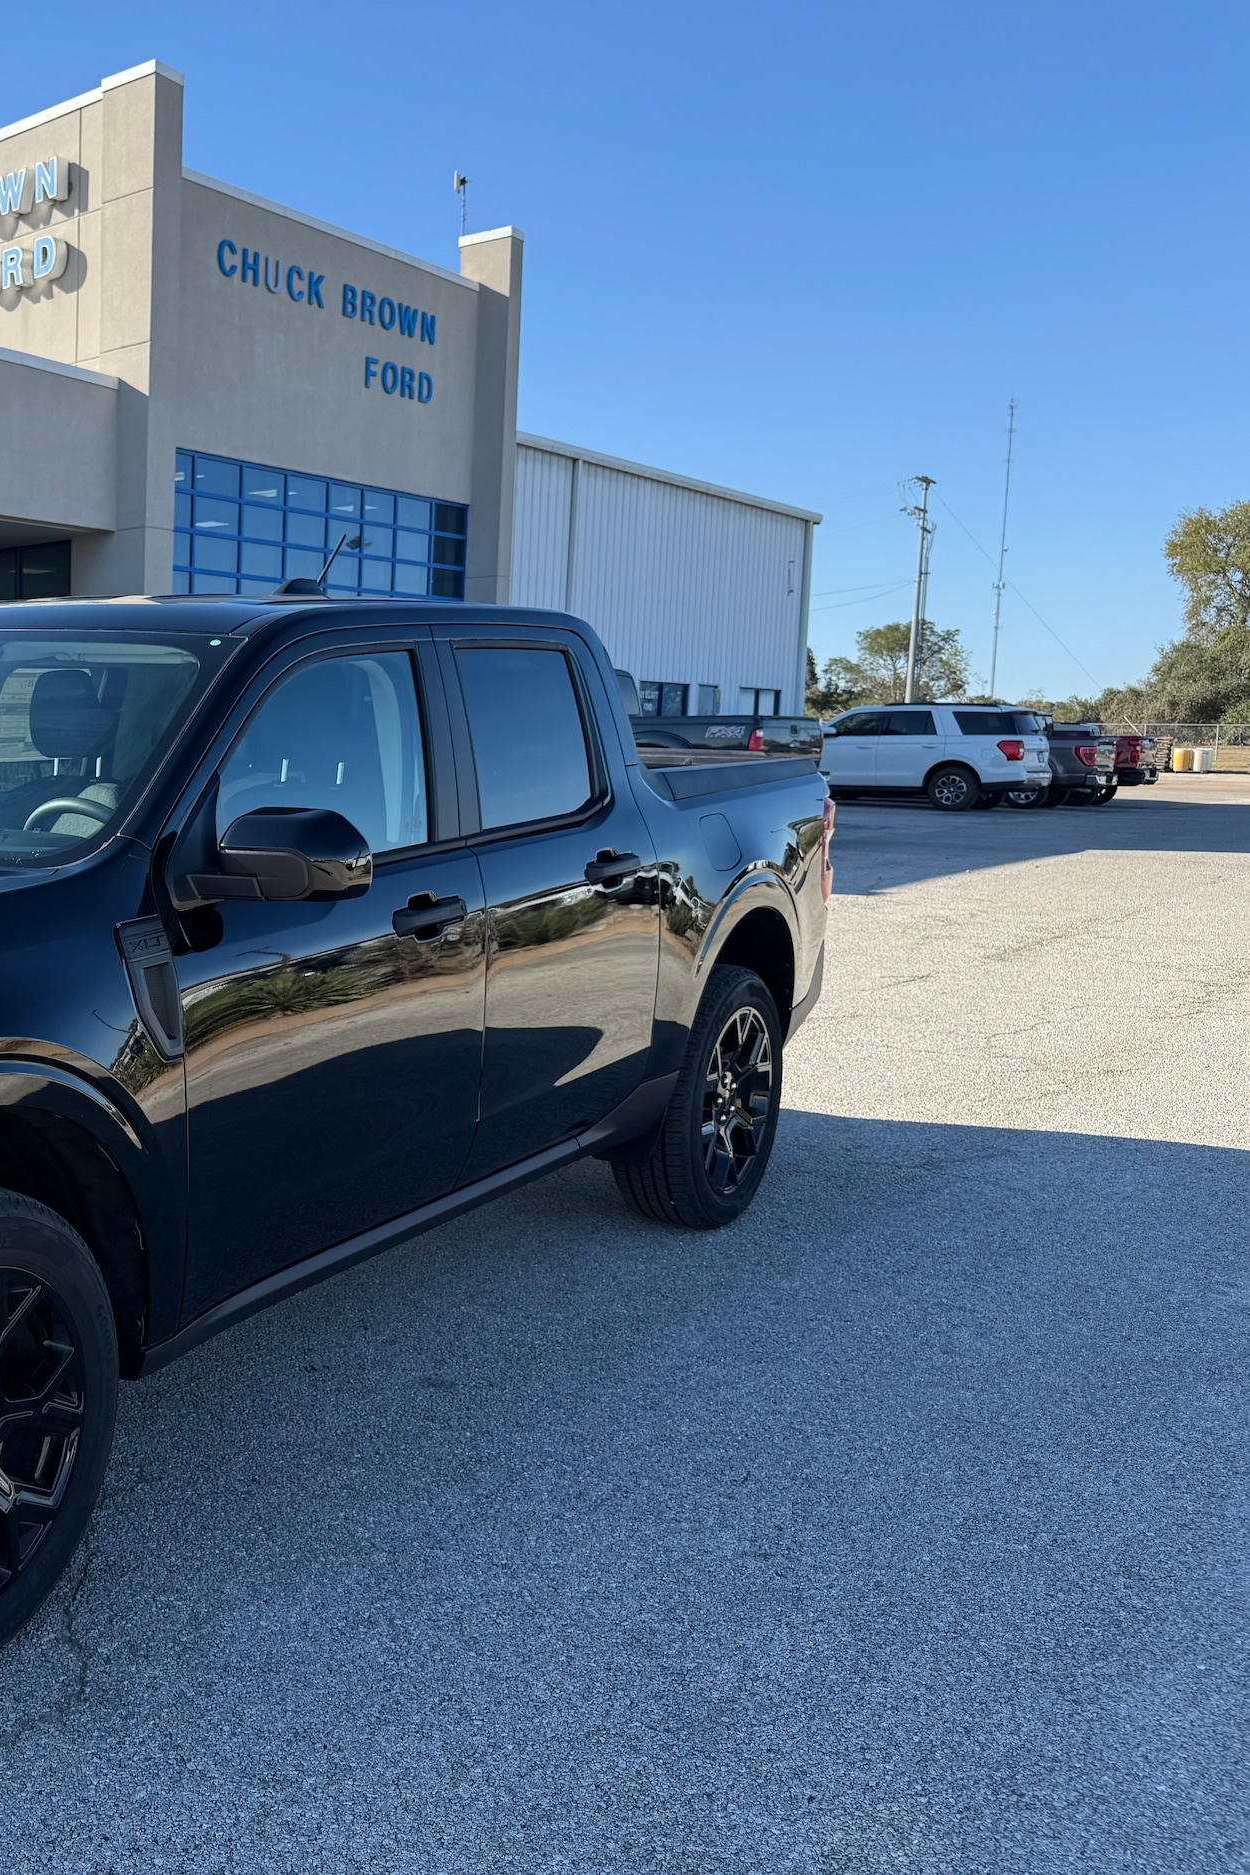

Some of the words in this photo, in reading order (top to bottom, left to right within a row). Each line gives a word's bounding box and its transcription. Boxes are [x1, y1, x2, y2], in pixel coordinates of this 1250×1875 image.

[217, 239, 325, 309] CHUCK
[342, 283, 437, 346] BROWN
[364, 356, 434, 405] FORD
